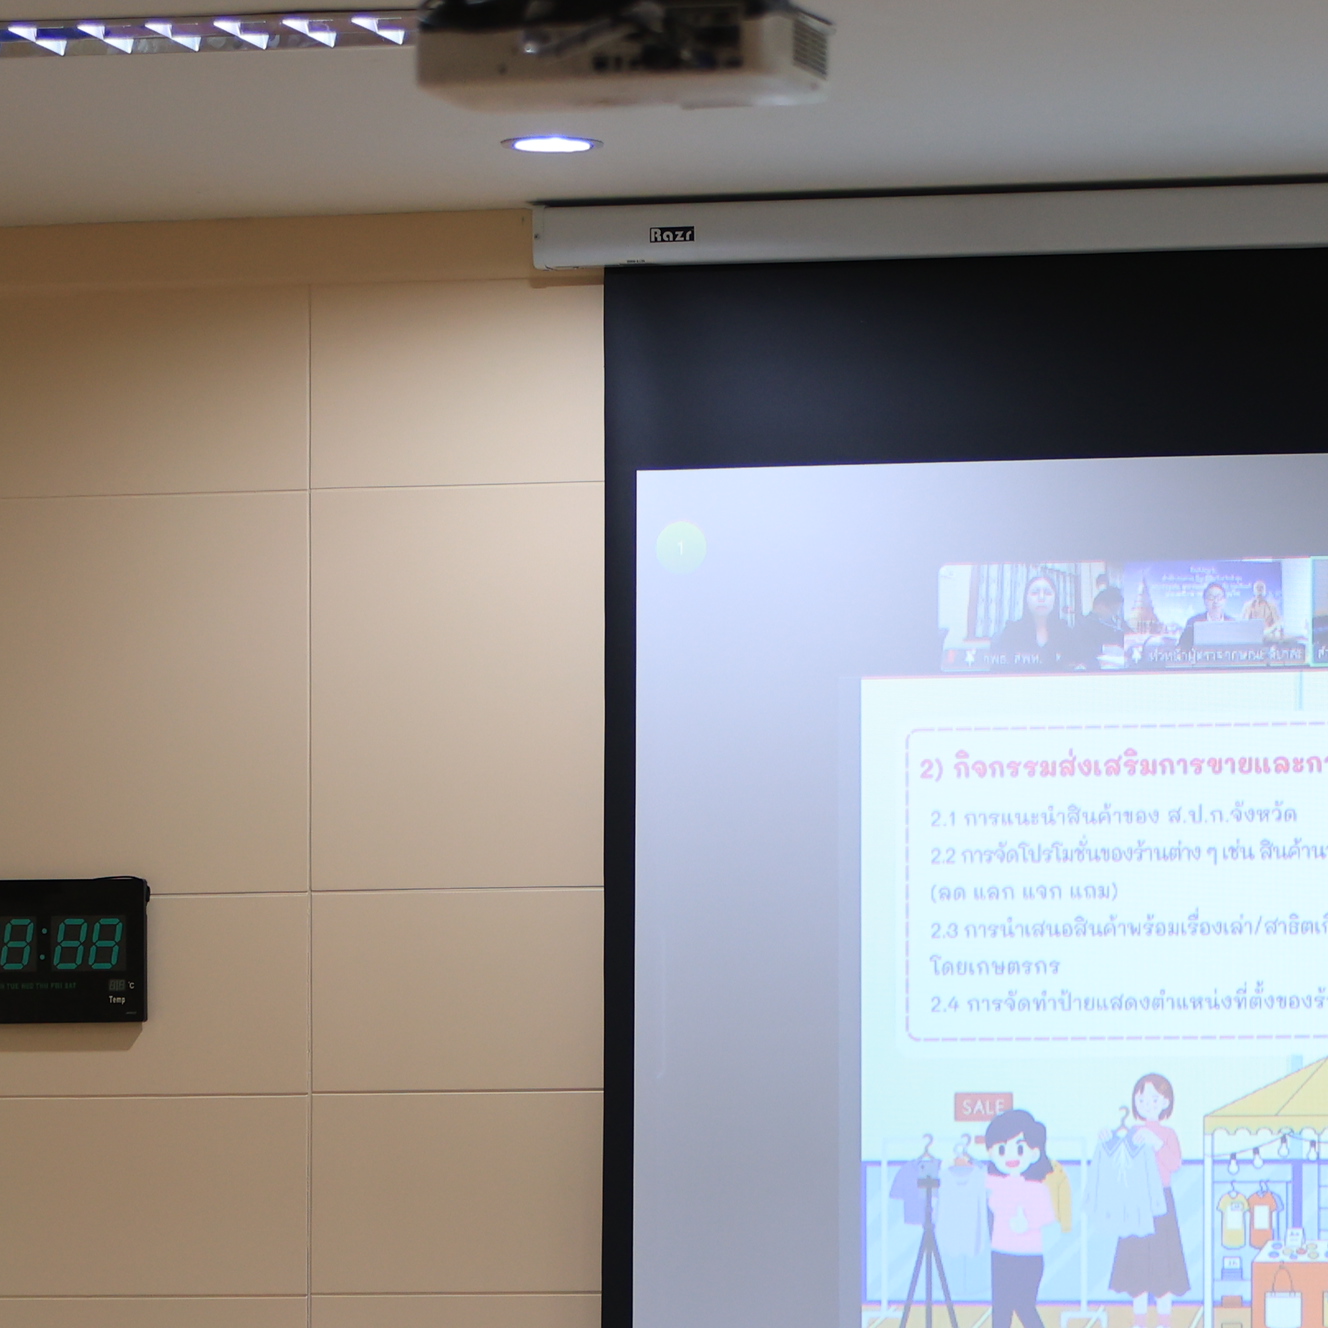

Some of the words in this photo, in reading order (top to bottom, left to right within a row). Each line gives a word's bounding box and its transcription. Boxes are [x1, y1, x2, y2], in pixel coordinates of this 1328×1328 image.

[650, 227, 691, 241] Razr
[919, 757, 944, 782] 2)
[930, 810, 955, 827] 2.1
[963, 803, 1160, 828] การแนะนำสินค้าของ
[1167, 800, 1298, 825] ส.ป.ก.จังหวัด
[930, 847, 956, 865] 2.2
[961, 835, 1202, 866] การจัดโปรโมชั่นของร้านต่าง
[1206, 844, 1218, 866] ๆ
[1222, 837, 1256, 861] เช่น
[930, 883, 966, 904] (ลด
[974, 884, 1014, 900] แลก
[1022, 883, 1061, 900] แจก
[1070, 882, 1120, 902] แถม)
[930, 922, 959, 939] 2.3
[928, 954, 1062, 977] โดยเกษตรกร
[108, 994, 126, 1005] Temp
[930, 995, 959, 1012] 2.4
[962, 1098, 1004, 1115] SALE
